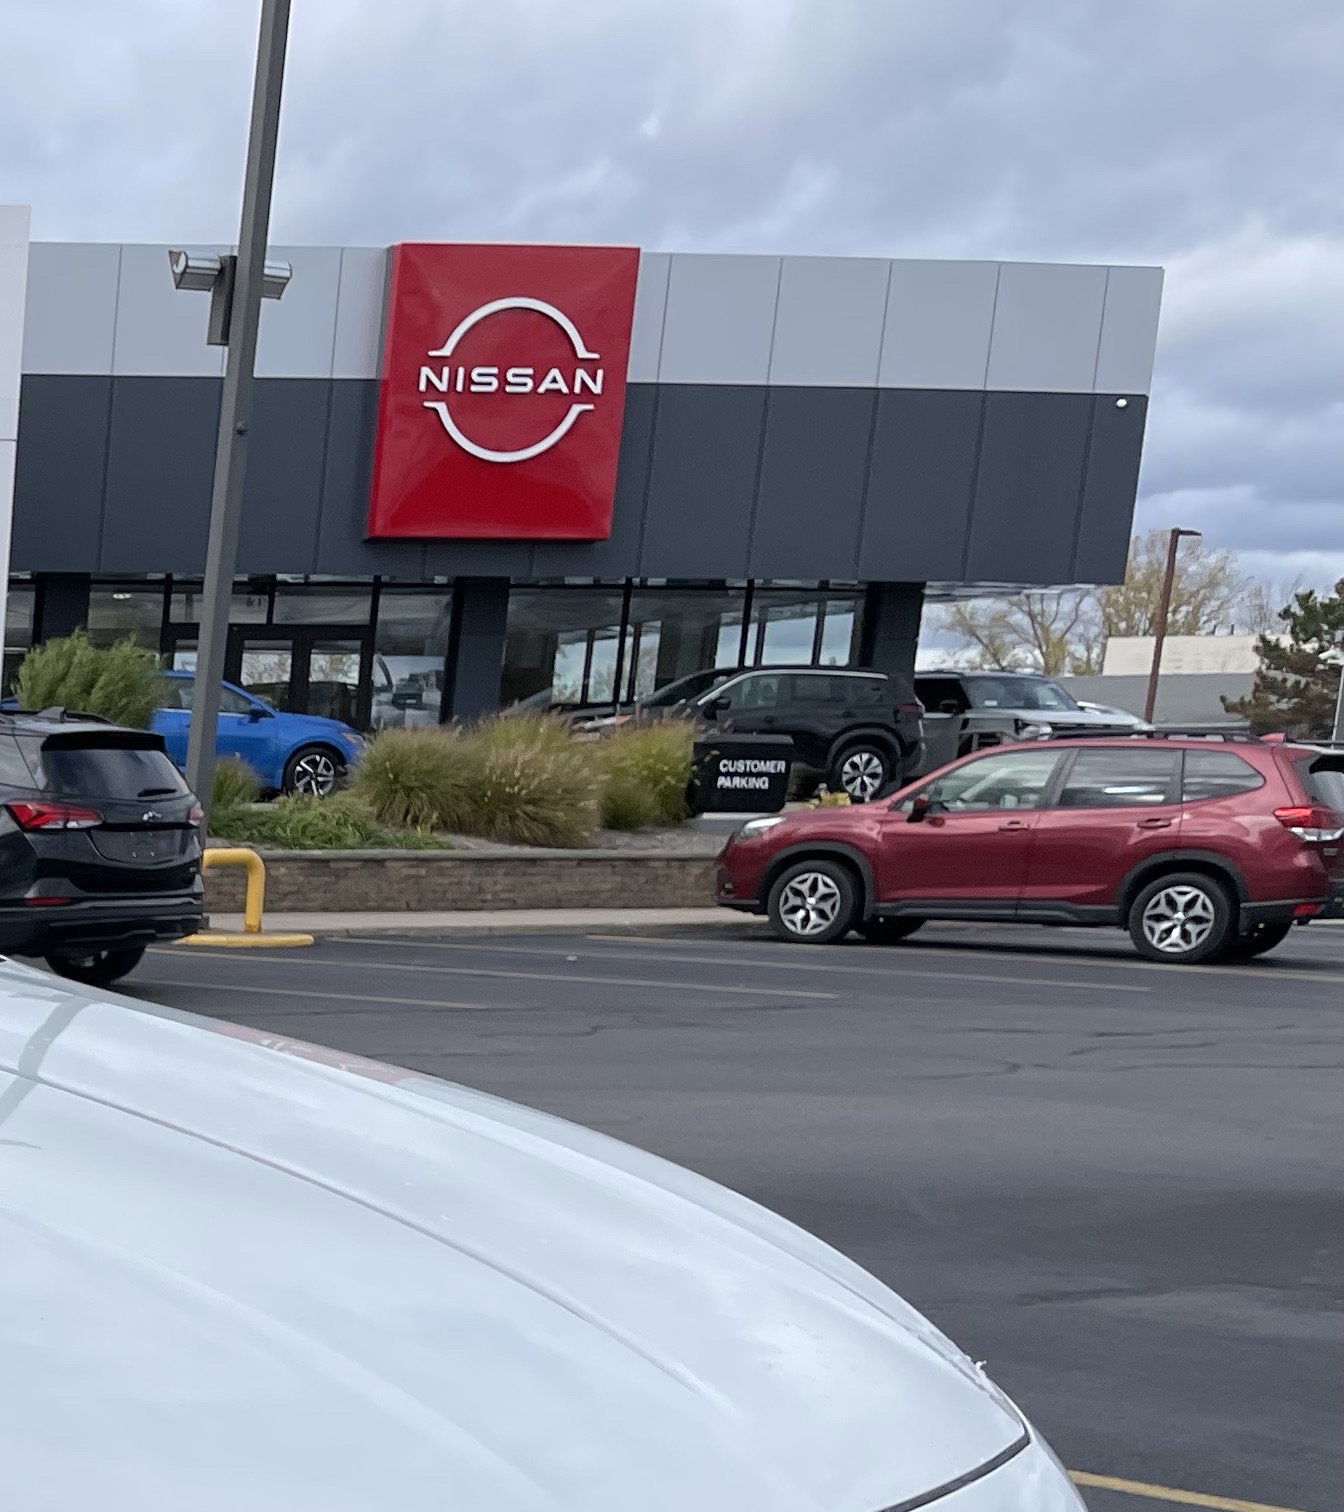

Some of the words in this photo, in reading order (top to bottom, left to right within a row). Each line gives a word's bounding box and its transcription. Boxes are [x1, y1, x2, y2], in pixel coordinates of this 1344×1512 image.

[418, 365, 604, 395] NISSAN
[718, 758, 787, 774] CUSTOMER
[716, 775, 769, 790] PARKING
